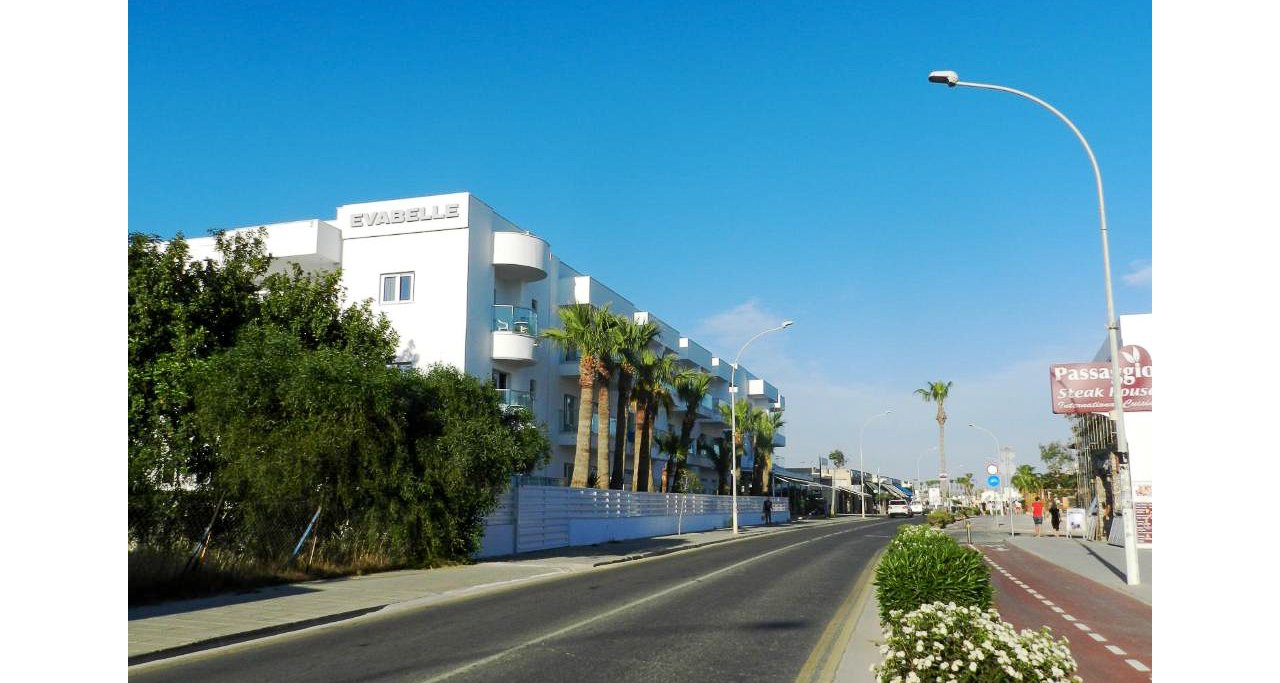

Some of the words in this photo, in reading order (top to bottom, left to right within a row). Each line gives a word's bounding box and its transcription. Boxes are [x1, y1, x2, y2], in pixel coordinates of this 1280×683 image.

[351, 204, 459, 227] EVABELLE
[1054, 362, 1152, 385] Passagio
[1059, 388, 1105, 399] Steak
